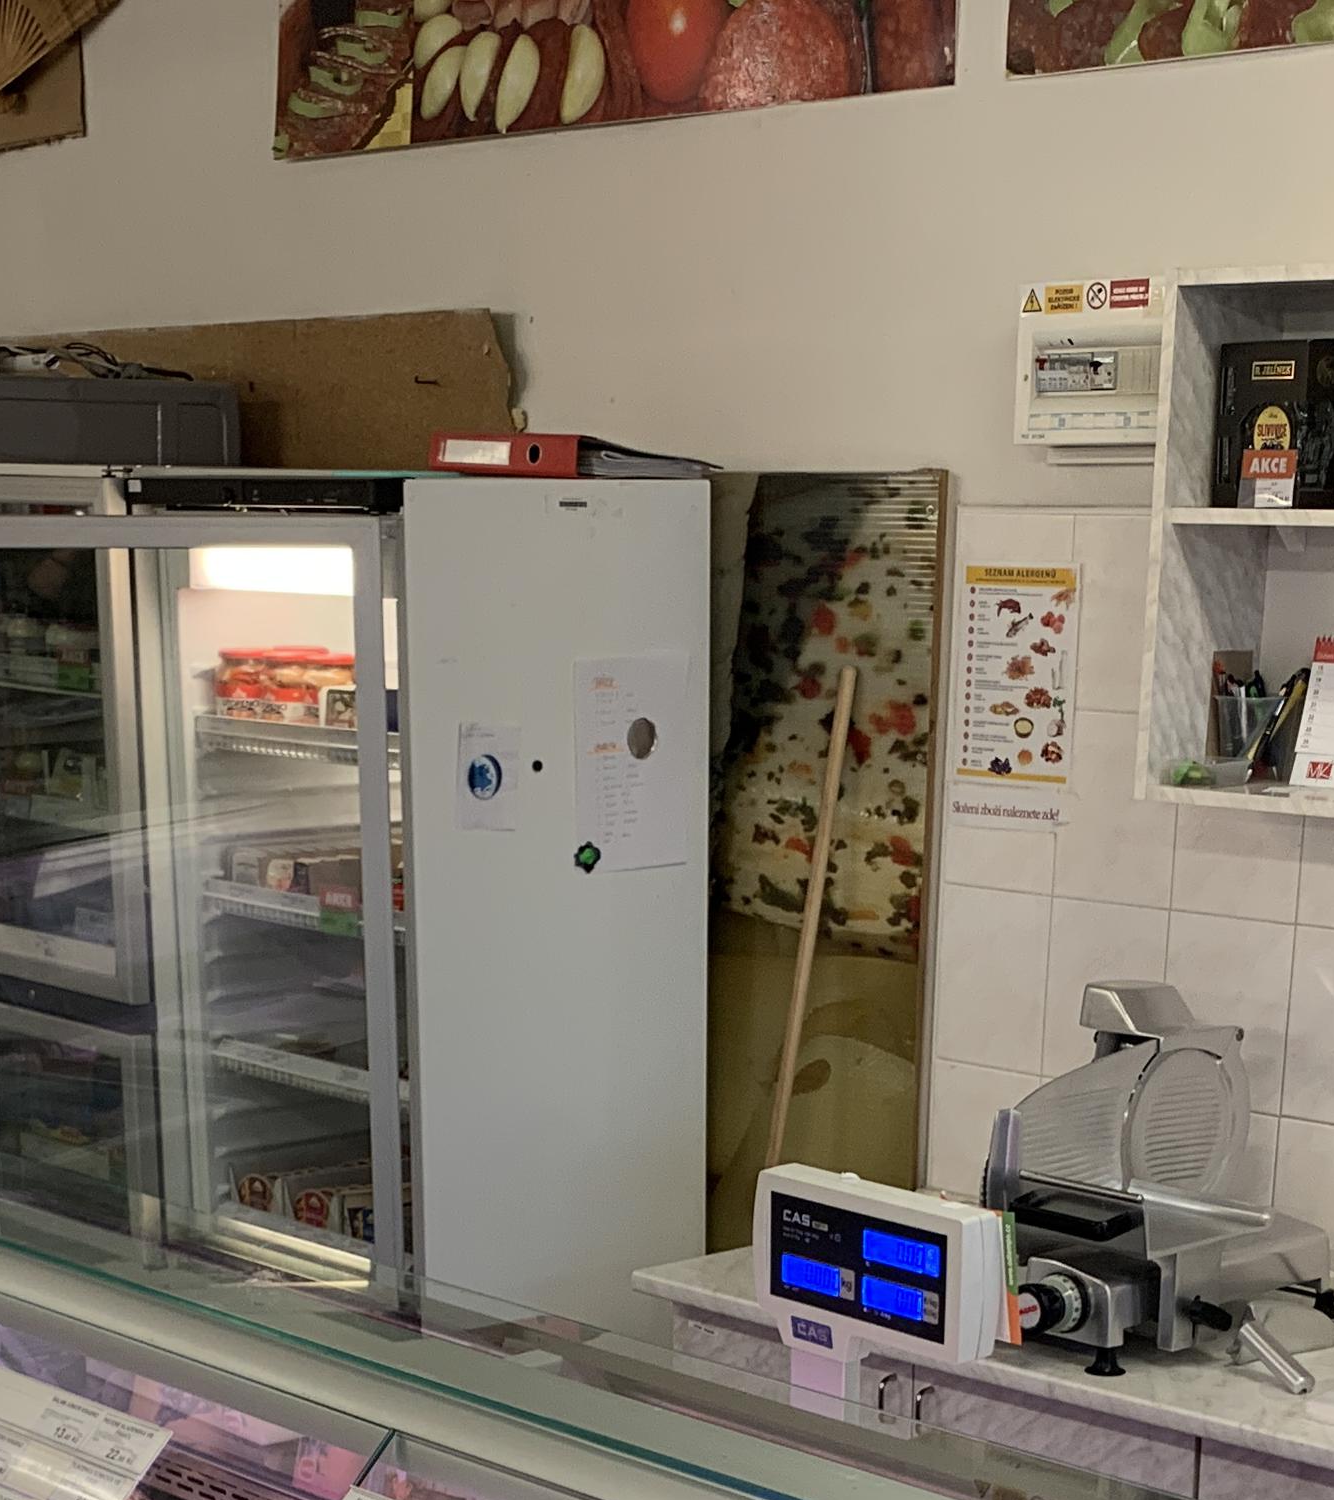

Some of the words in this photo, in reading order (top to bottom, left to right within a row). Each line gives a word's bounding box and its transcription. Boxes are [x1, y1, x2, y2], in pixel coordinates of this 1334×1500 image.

[1250, 457, 1288, 474] AKCE
[984, 568, 1015, 578] SEZNAM
[1016, 568, 1057, 579] ALERGENŮ
[980, 801, 1001, 817] zboží
[1002, 804, 1040, 820] naleznete
[325, 894, 352, 906] AKCE
[783, 1209, 810, 1226] CAS
[841, 1277, 852, 1292] kg
[797, 1322, 828, 1342] CAS
